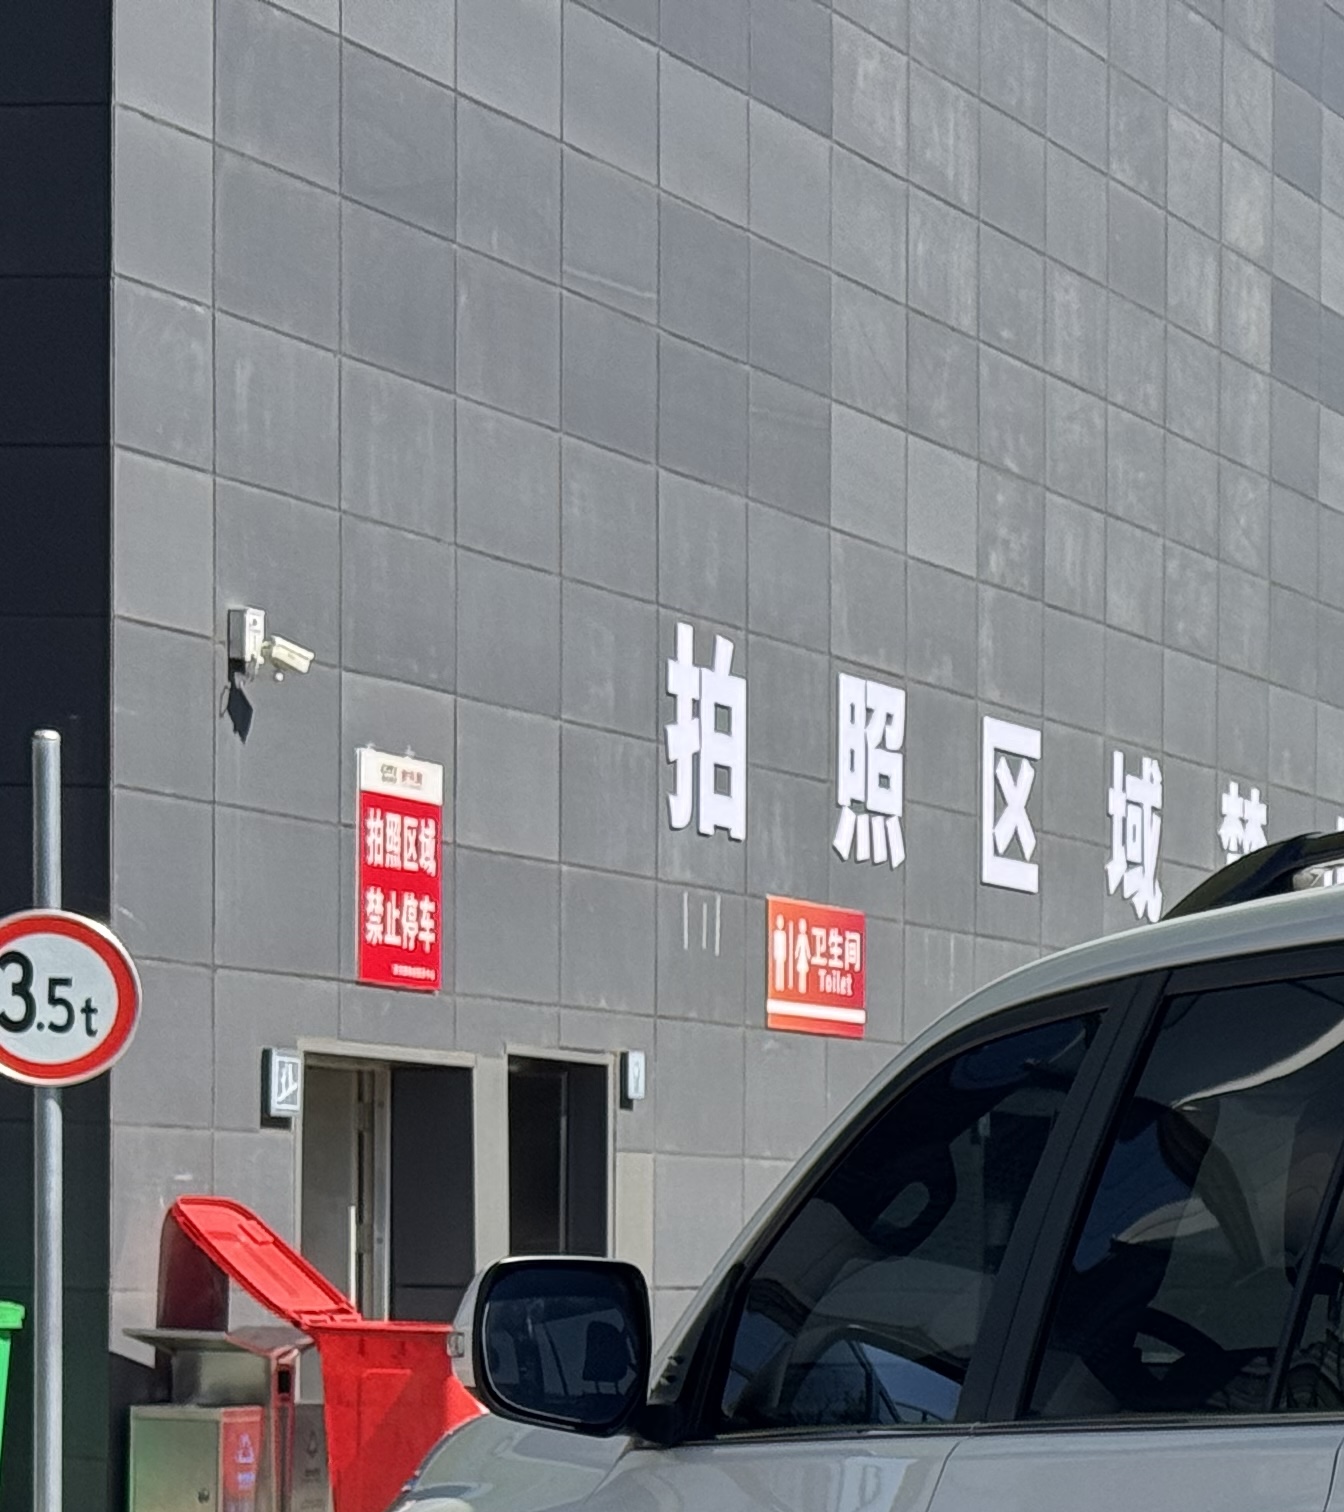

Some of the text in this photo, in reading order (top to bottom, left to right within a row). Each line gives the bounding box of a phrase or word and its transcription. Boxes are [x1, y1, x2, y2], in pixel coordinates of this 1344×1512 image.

[365, 806, 437, 878] 拍照区域
[365, 885, 437, 954] 禁止停车
[810, 926, 861, 973] 卫生间
[0, 951, 99, 1037] 3.5t
[818, 968, 854, 997] Toilet
